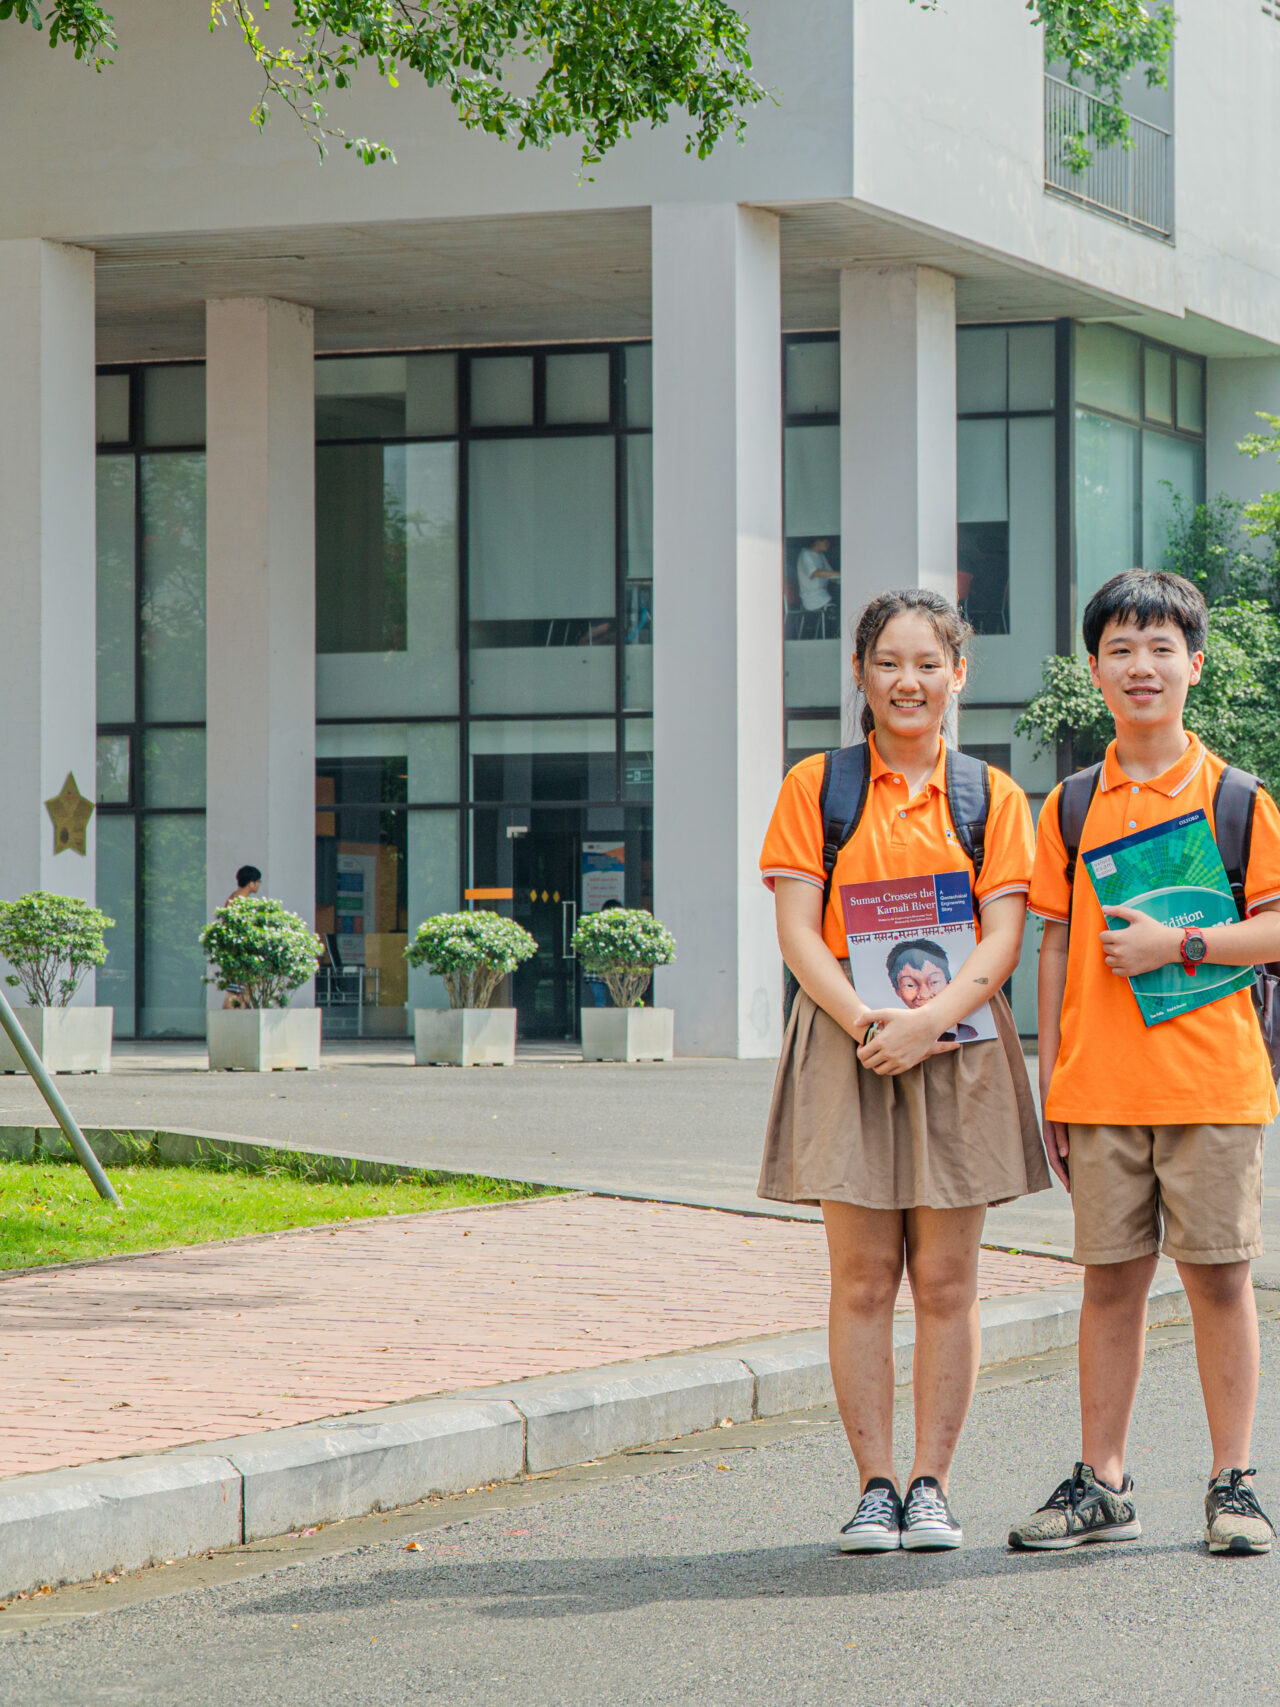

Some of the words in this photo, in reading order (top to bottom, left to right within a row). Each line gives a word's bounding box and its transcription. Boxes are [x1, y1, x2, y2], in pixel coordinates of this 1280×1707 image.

[850, 896, 881, 906] Suman
[883, 892, 918, 902] Crosses
[920, 888, 934, 898] the
[876, 902, 909, 915] Karnali
[911, 901, 936, 911] River
